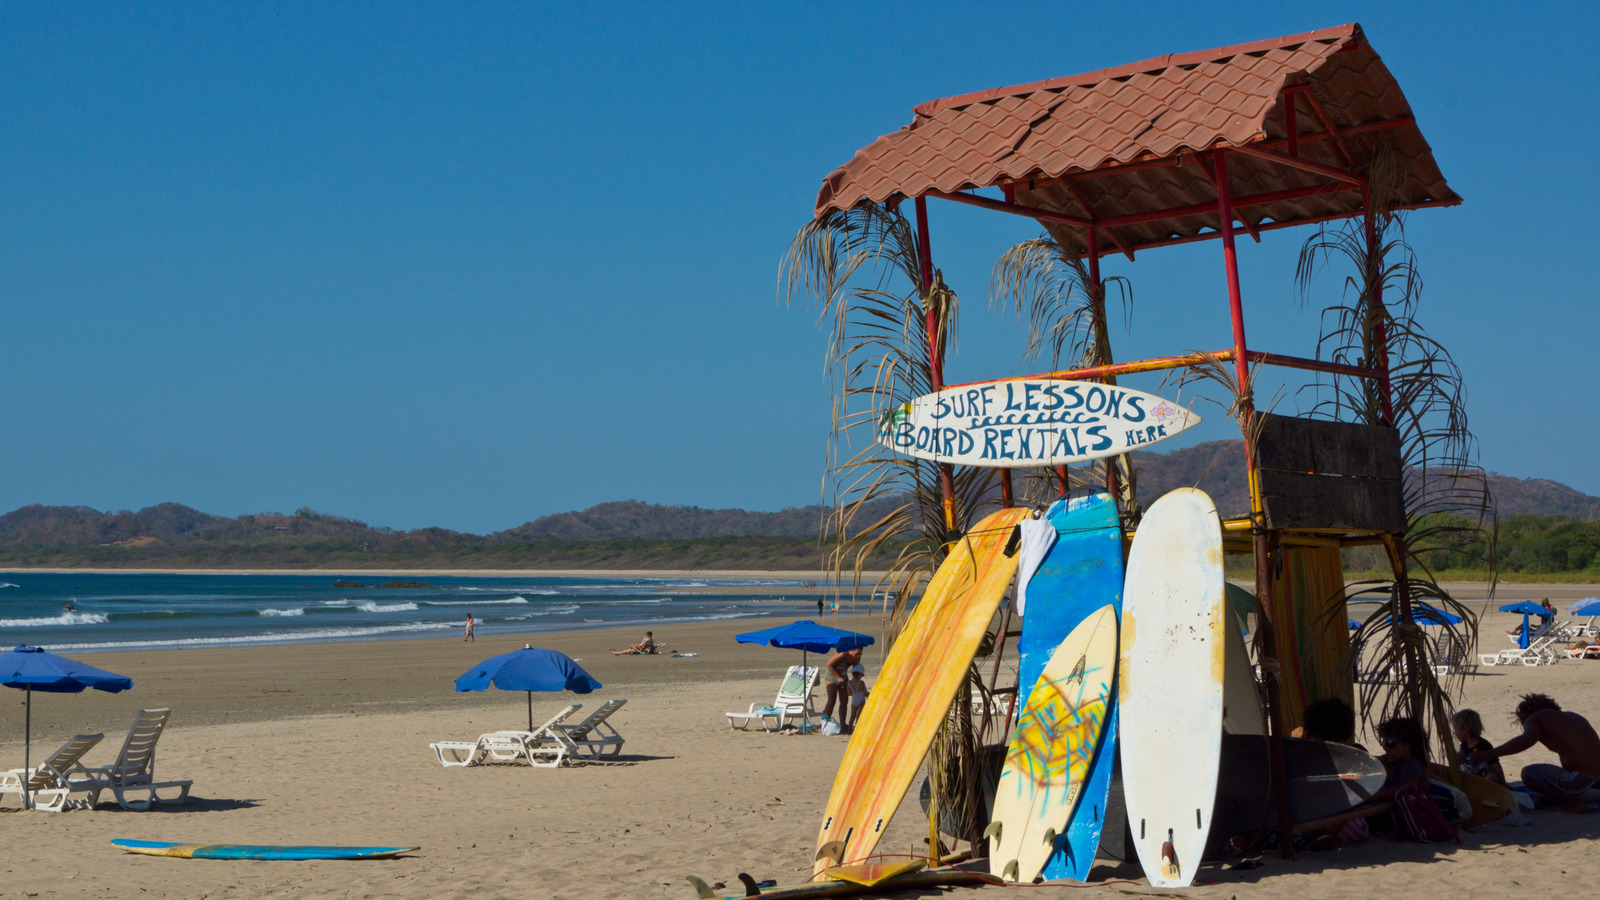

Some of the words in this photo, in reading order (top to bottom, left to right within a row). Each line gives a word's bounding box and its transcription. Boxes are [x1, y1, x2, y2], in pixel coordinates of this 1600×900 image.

[930, 385, 996, 419] SURF
[1003, 382, 1146, 423] LESSONS
[895, 422, 974, 457] BOARD
[978, 425, 1113, 460] RENTALS
[1126, 424, 1168, 447] HERE
